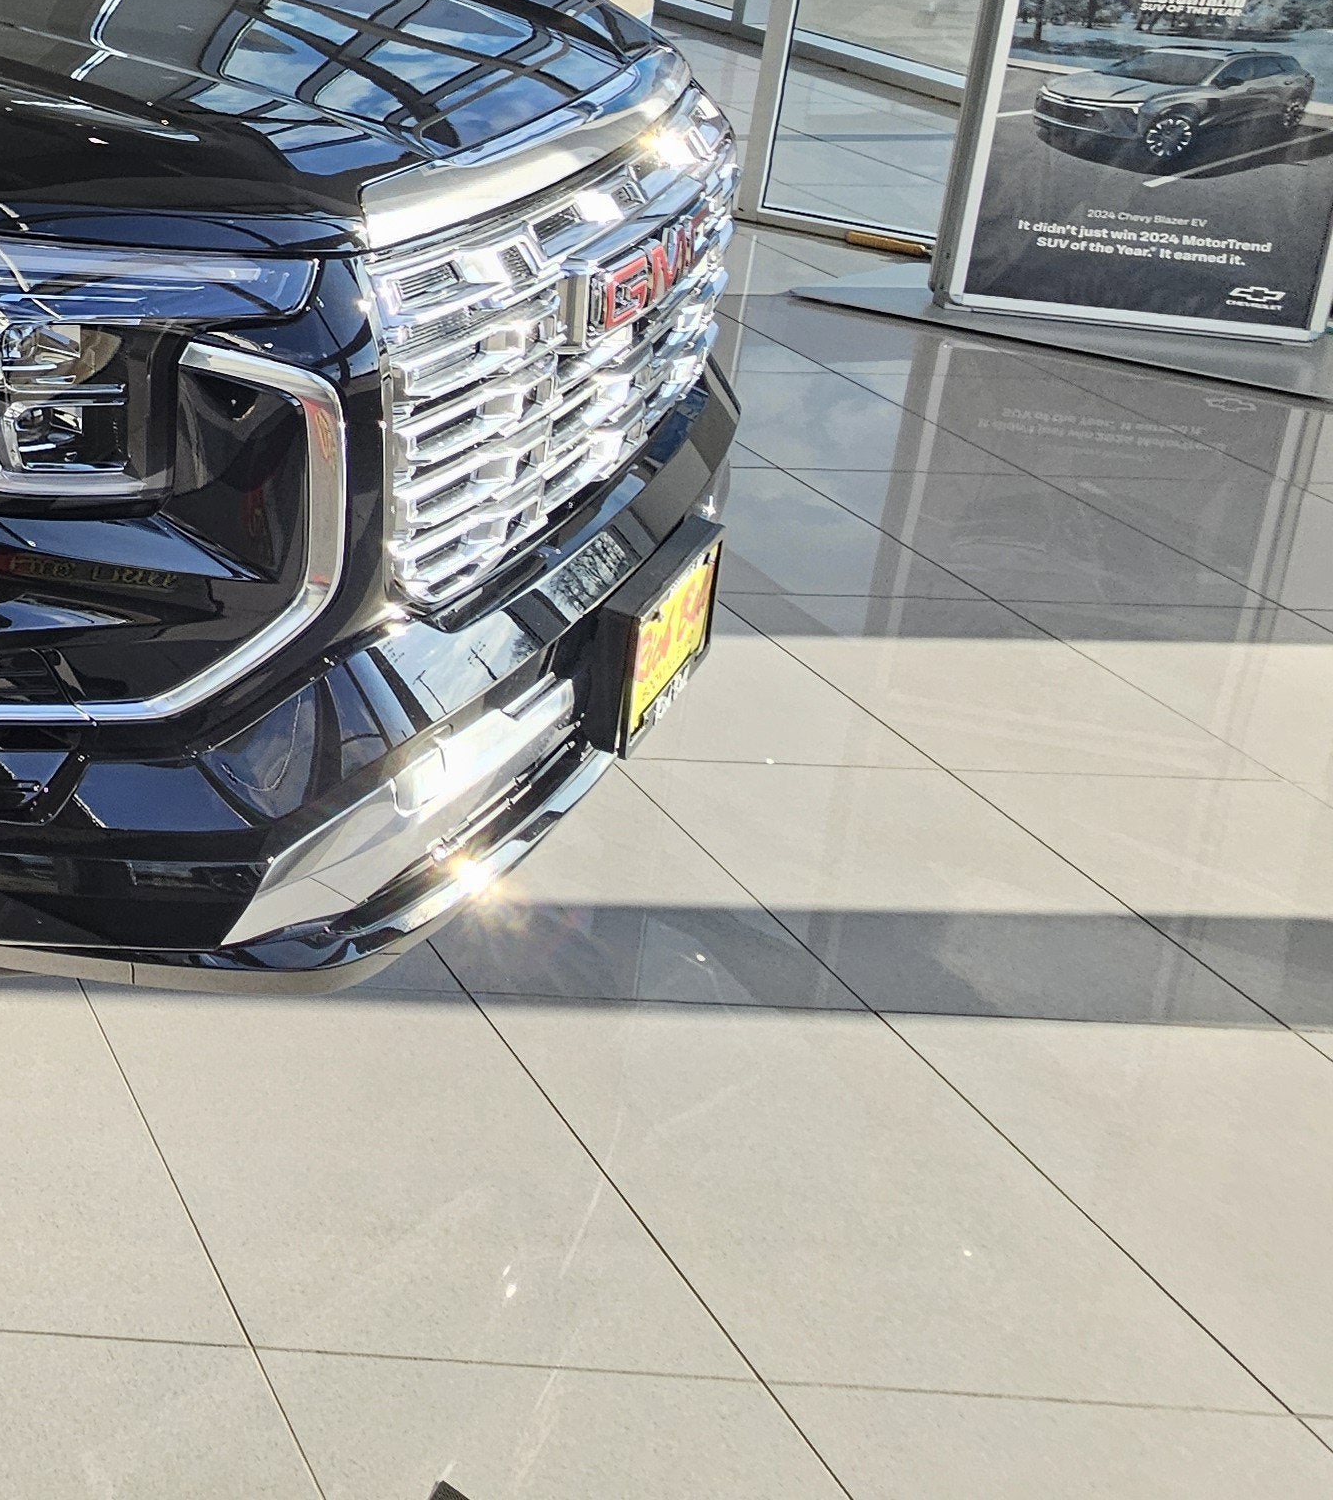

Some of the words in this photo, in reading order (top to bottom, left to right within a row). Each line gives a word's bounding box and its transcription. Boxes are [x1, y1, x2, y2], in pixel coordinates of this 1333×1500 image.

[1139, 2, 1166, 12] SUV
[1166, 3, 1185, 13] OF
[1185, 5, 1210, 14] THE
[1211, 7, 1243, 17] YEAR
[1087, 209, 1116, 219] 2024
[1117, 211, 1153, 224] Chevy
[1153, 214, 1190, 225] Blazer
[1191, 218, 1208, 227] EV
[1017, 219, 1031, 231] It
[1078, 225, 1110, 238] just
[1110, 229, 1138, 241] win
[1139, 231, 1180, 245] 2024
[1181, 234, 1273, 252] MotorTrend
[1036, 236, 1070, 249] SUV
[1070, 240, 1088, 251] of
[1088, 241, 1114, 254] the
[1159, 248, 1172, 260] It
[1173, 251, 1228, 265] earned
[1229, 253, 1246, 266] it.
[1225, 299, 1284, 311] CHEVROLET
